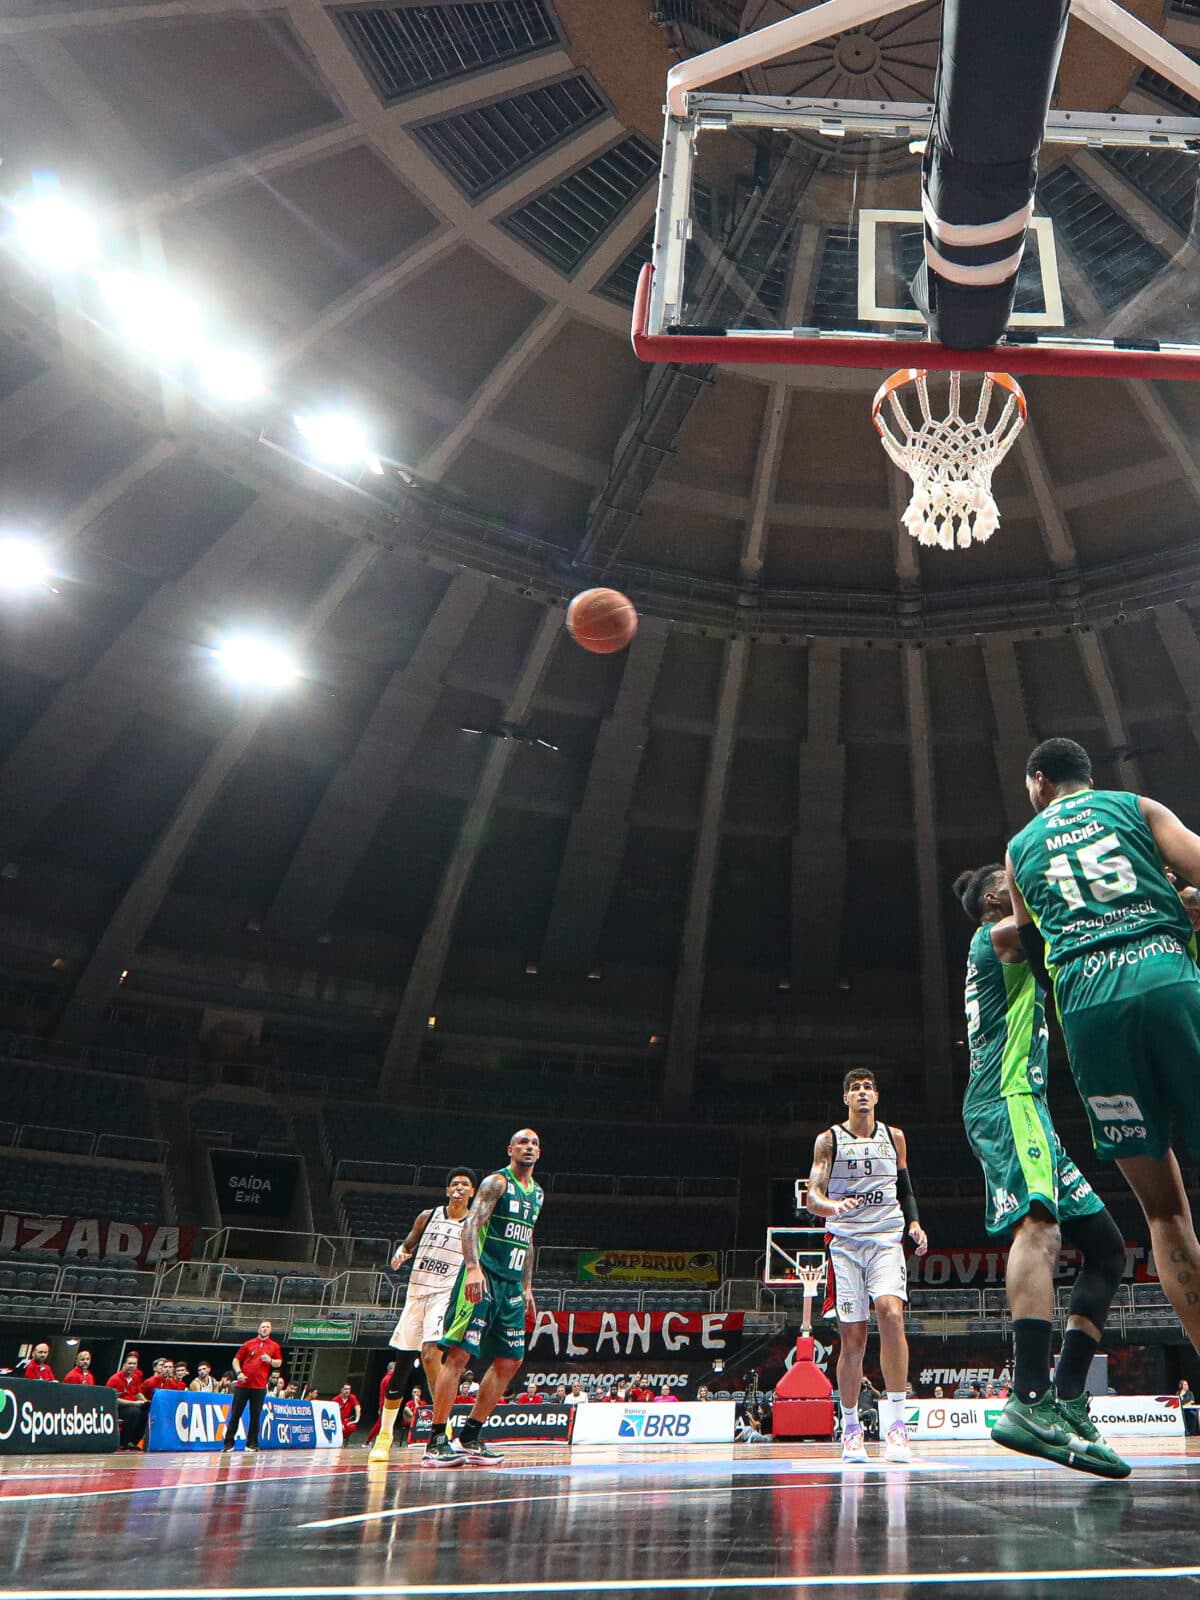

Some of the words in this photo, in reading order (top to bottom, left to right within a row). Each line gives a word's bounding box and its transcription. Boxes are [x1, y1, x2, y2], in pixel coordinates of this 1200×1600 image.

[1045, 820, 1105, 852] MACIEL
[1043, 832, 1138, 911] 15
[864, 1160, 873, 1176] 9
[228, 1175, 271, 1191] SAÍDA
[235, 1190, 260, 1204] Exit
[426, 1260, 449, 1275] BRB
[508, 1247, 526, 1271] 10
[523, 1372, 625, 1387] JOGAREMOS
[628, 1373, 689, 1388] JNTOS
[20, 1401, 114, 1443] Sportsbet.io
[643, 1414, 692, 1437] BRB
[950, 1409, 978, 1428] gali
[1090, 1412, 1177, 1424] O.COM.BR/ANJO
